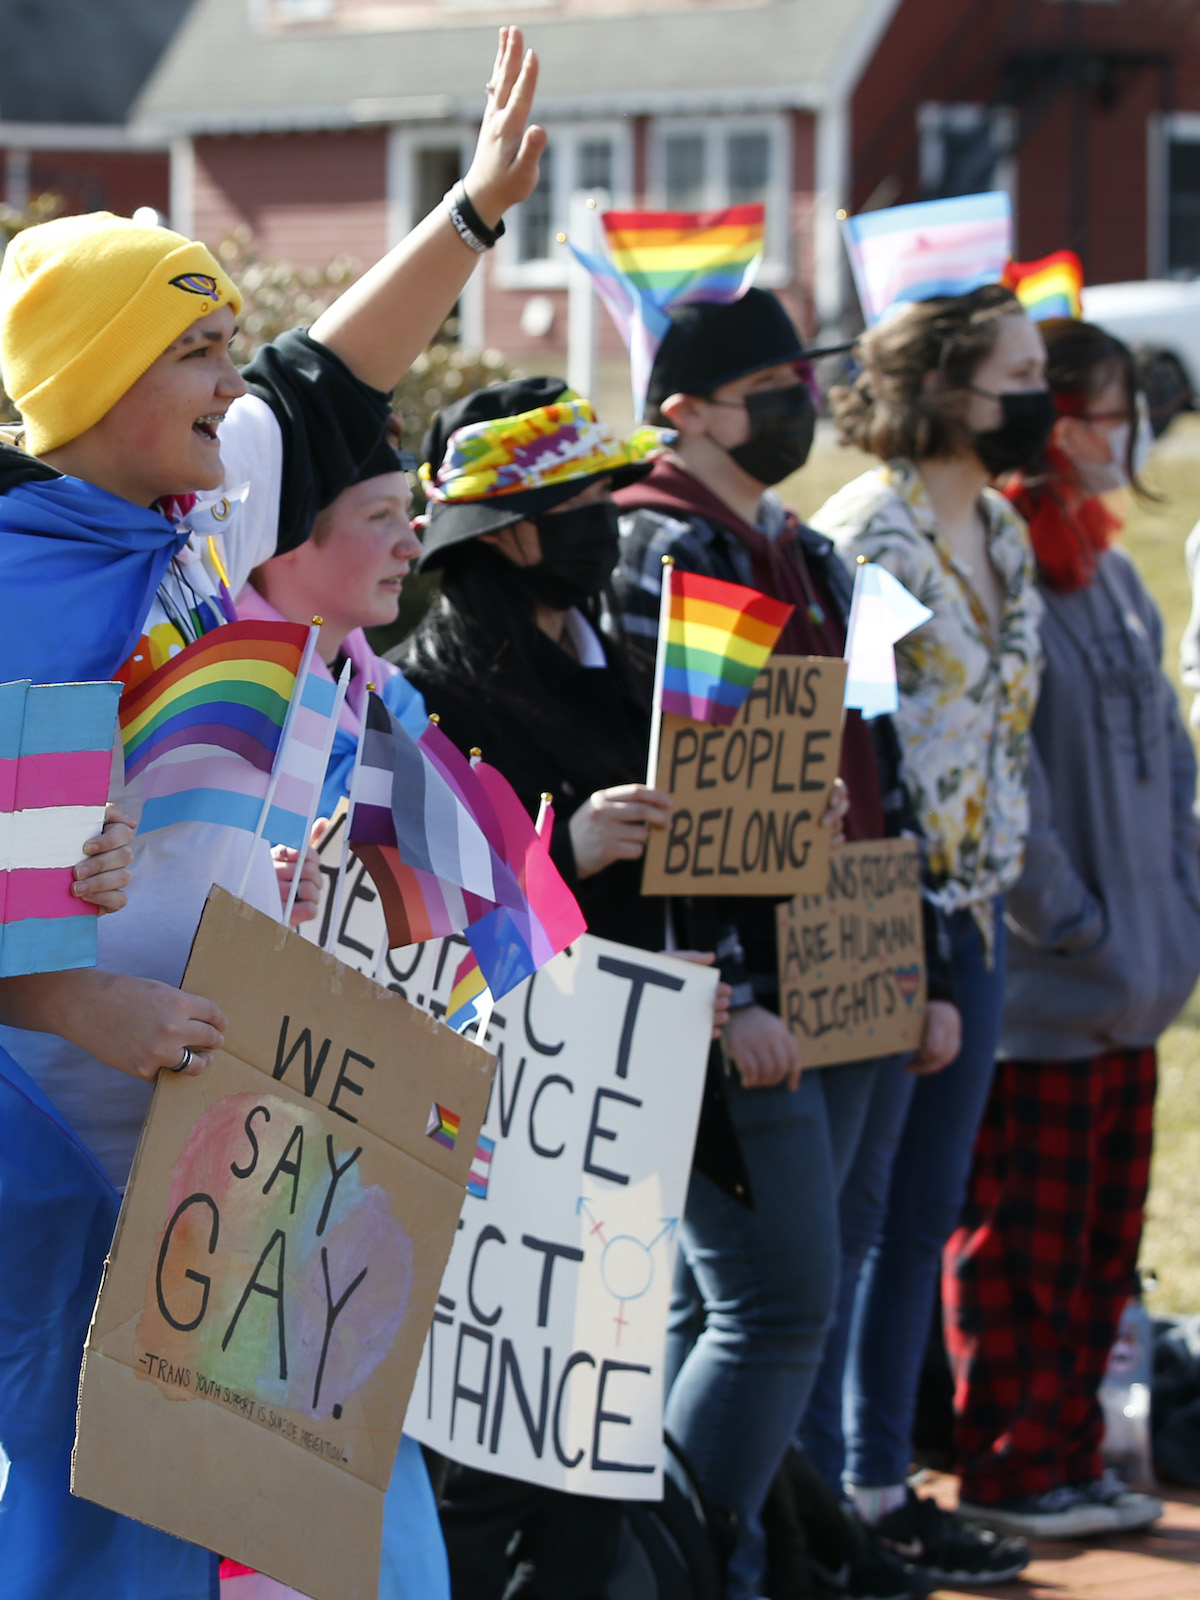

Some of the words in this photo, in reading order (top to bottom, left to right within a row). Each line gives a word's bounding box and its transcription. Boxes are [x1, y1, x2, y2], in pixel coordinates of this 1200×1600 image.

[669, 727, 832, 794] PEOPLE
[664, 807, 814, 877] BELONG
[783, 922, 835, 983] ARE
[840, 911, 916, 963] HUMAN
[787, 967, 897, 1038] RIGHTS
[272, 1014, 376, 1123] WE
[230, 1105, 363, 1236] SAY
[155, 1192, 368, 1420] GAY.
[195, 1371, 222, 1399] YOUTH
[223, 1387, 255, 1418] SUPPORT
[257, 1406, 266, 1422] IS
